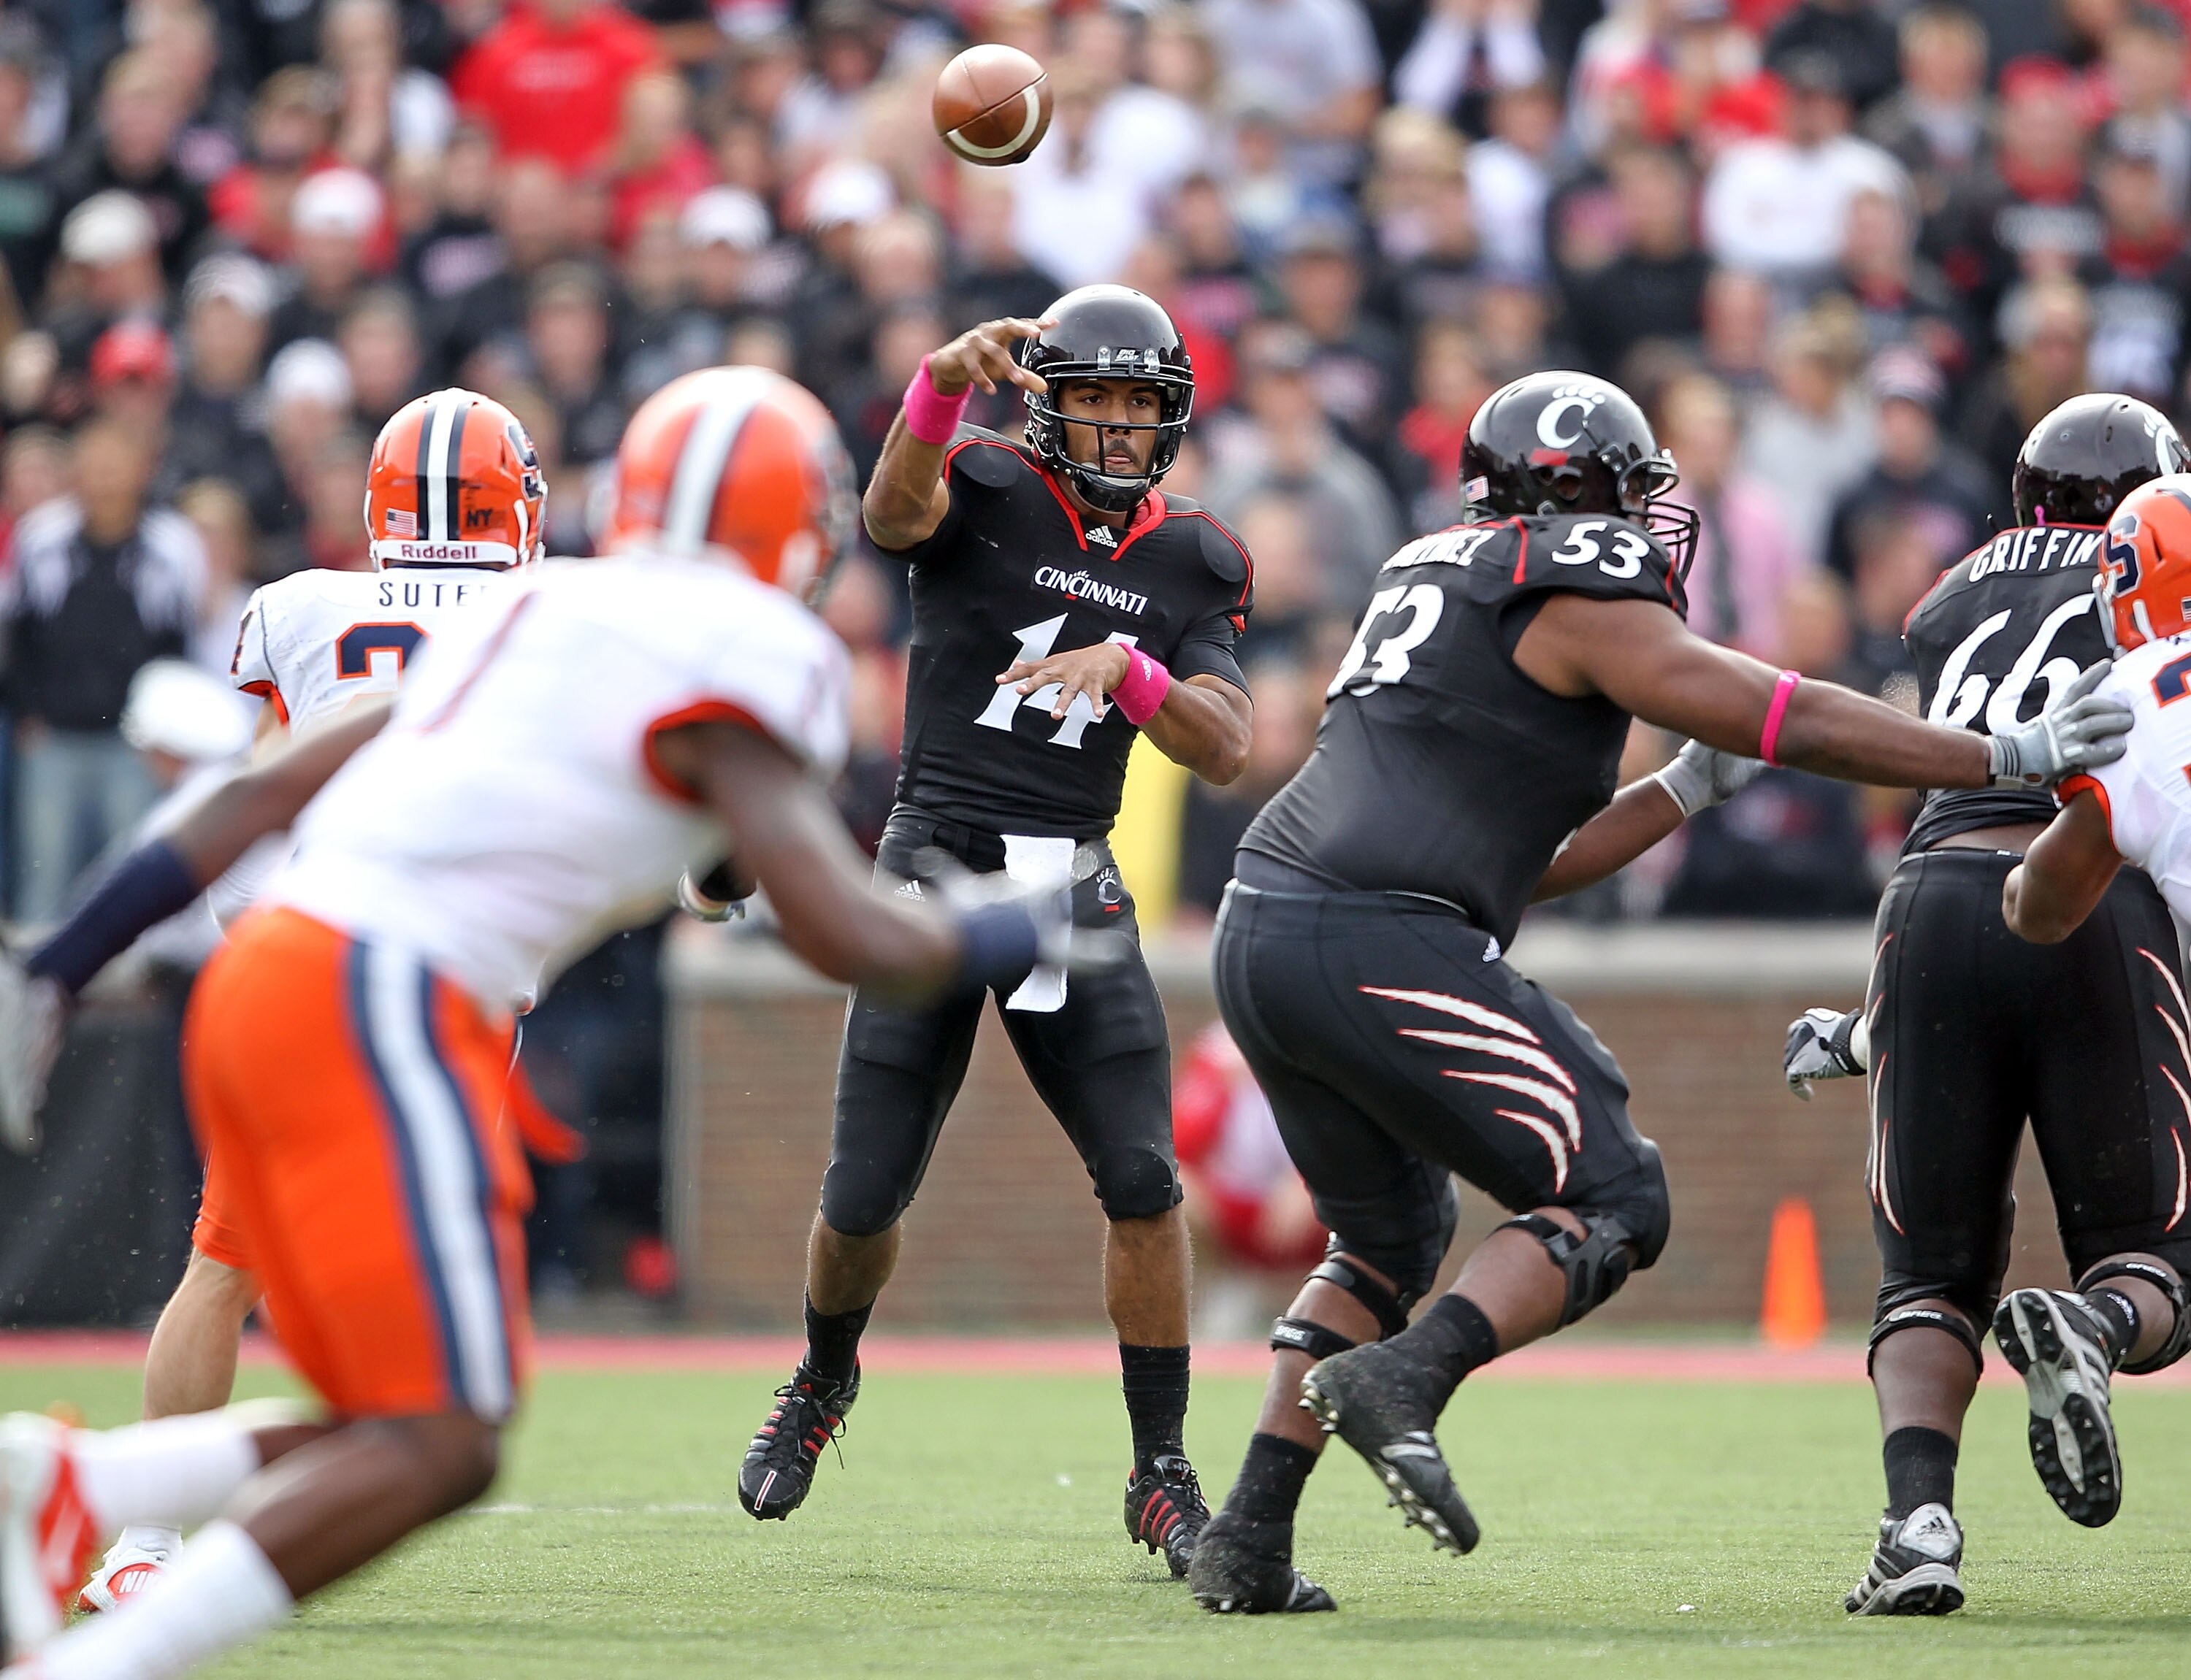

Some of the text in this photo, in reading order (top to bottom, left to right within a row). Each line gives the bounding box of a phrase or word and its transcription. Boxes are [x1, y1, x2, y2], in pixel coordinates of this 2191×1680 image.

[1537, 395, 1597, 449] C
[467, 508, 493, 526] NY
[401, 545, 478, 560] Riddell
[1085, 532, 1118, 548] adidas
[1551, 521, 1651, 579] 53
[1969, 527, 2103, 583] GRIFFIN
[379, 582, 492, 607] SUTE
[1034, 566, 1149, 615] CINCINNATI
[974, 612, 1139, 750] 14
[1928, 593, 2096, 735] 66
[894, 890, 926, 903] adidas
[118, 1570, 158, 1594] NI
